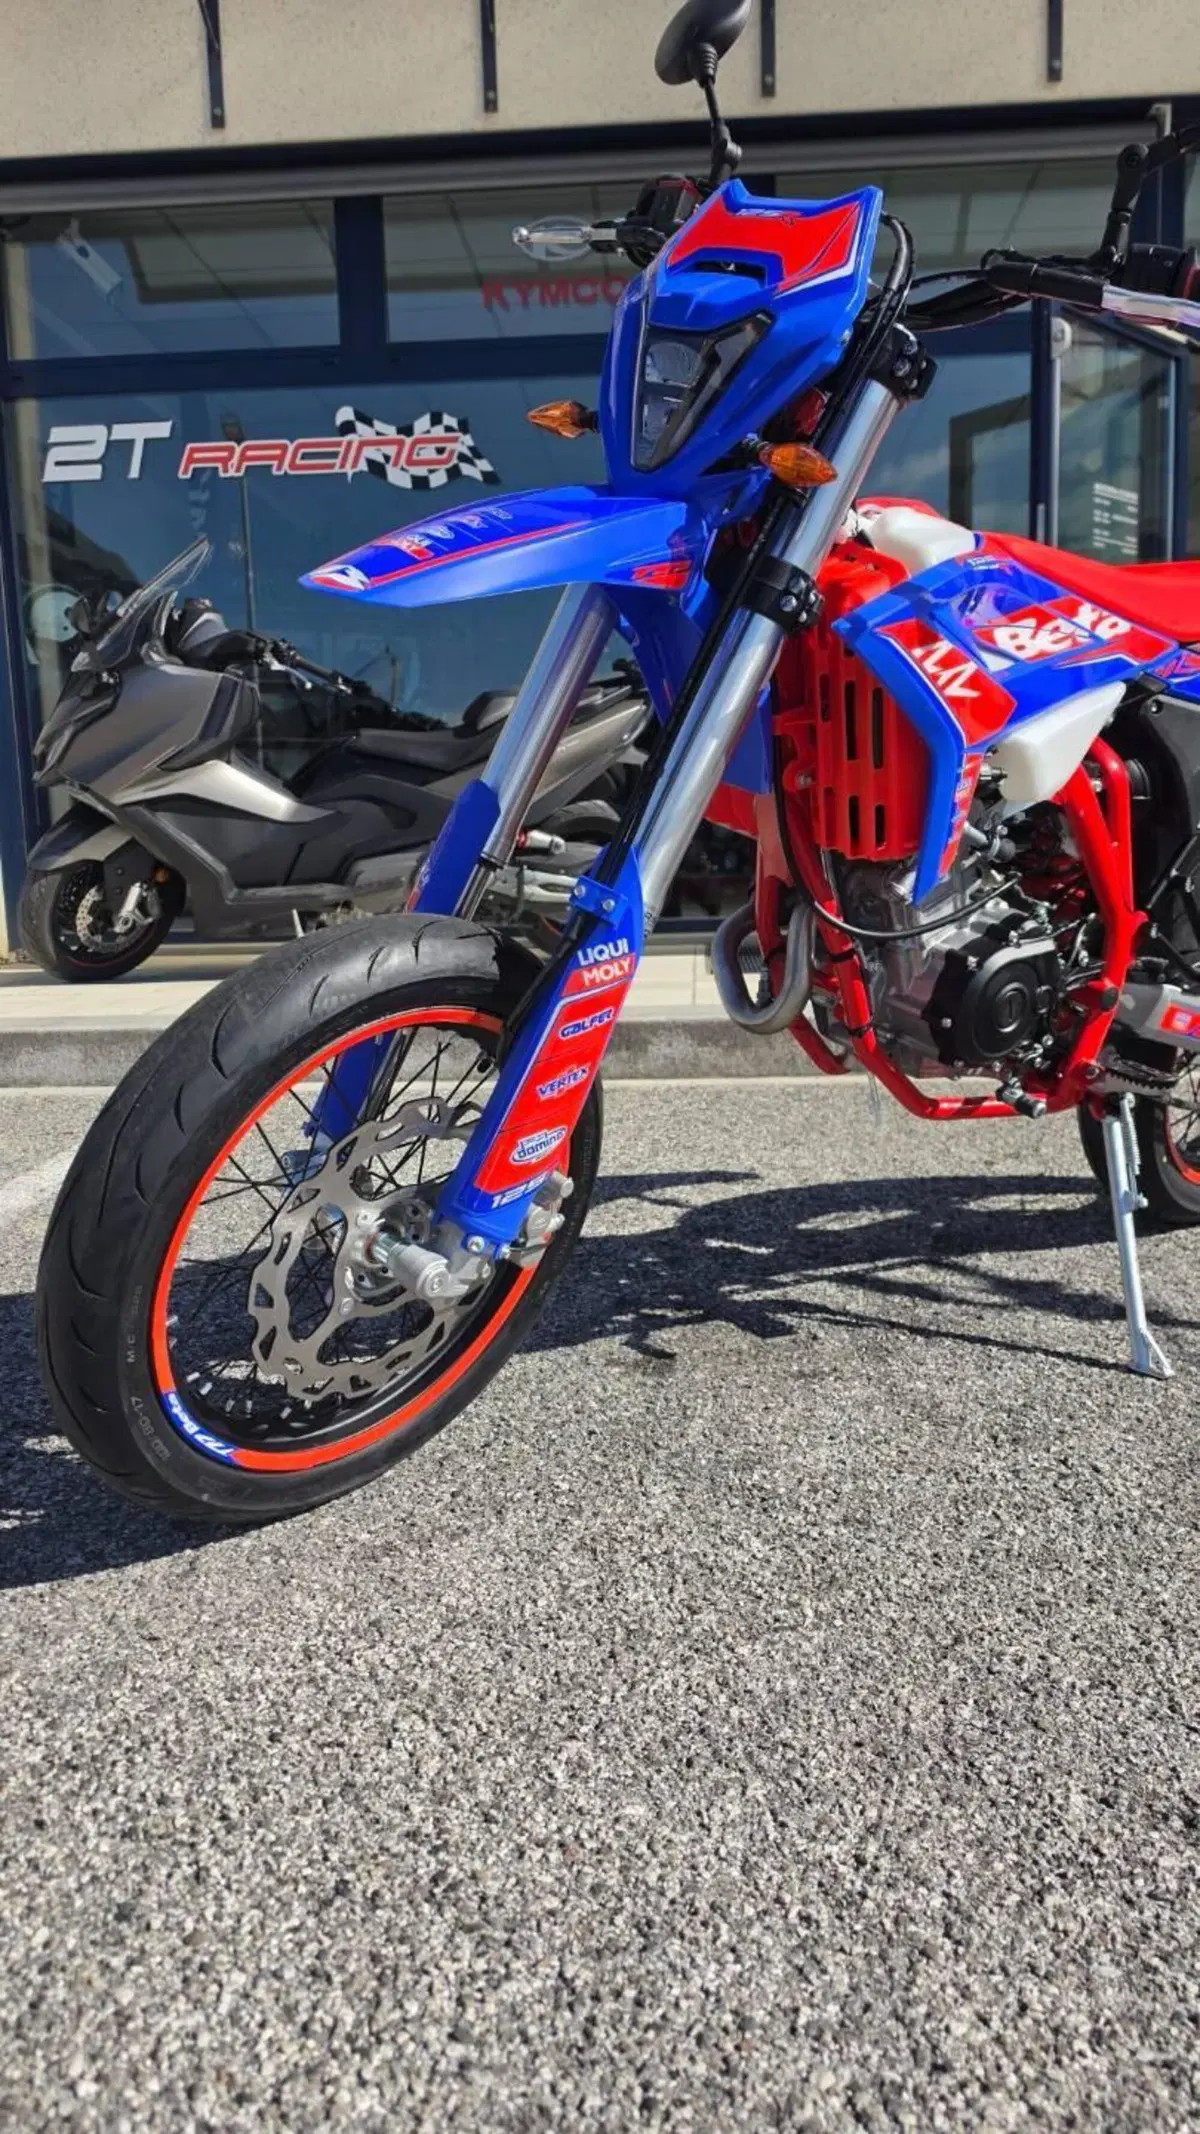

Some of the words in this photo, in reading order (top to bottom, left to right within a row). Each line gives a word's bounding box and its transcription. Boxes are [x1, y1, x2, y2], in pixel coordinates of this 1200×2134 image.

[481, 275, 628, 313] KYMCO
[42, 420, 173, 482] 2T
[177, 433, 463, 480] RACING
[577, 938, 629, 967] LIQUI
[582, 957, 632, 987] MOLY
[560, 1008, 613, 1038] GALFER
[537, 1067, 589, 1099] VERTEX
[517, 1130, 564, 1159] domino
